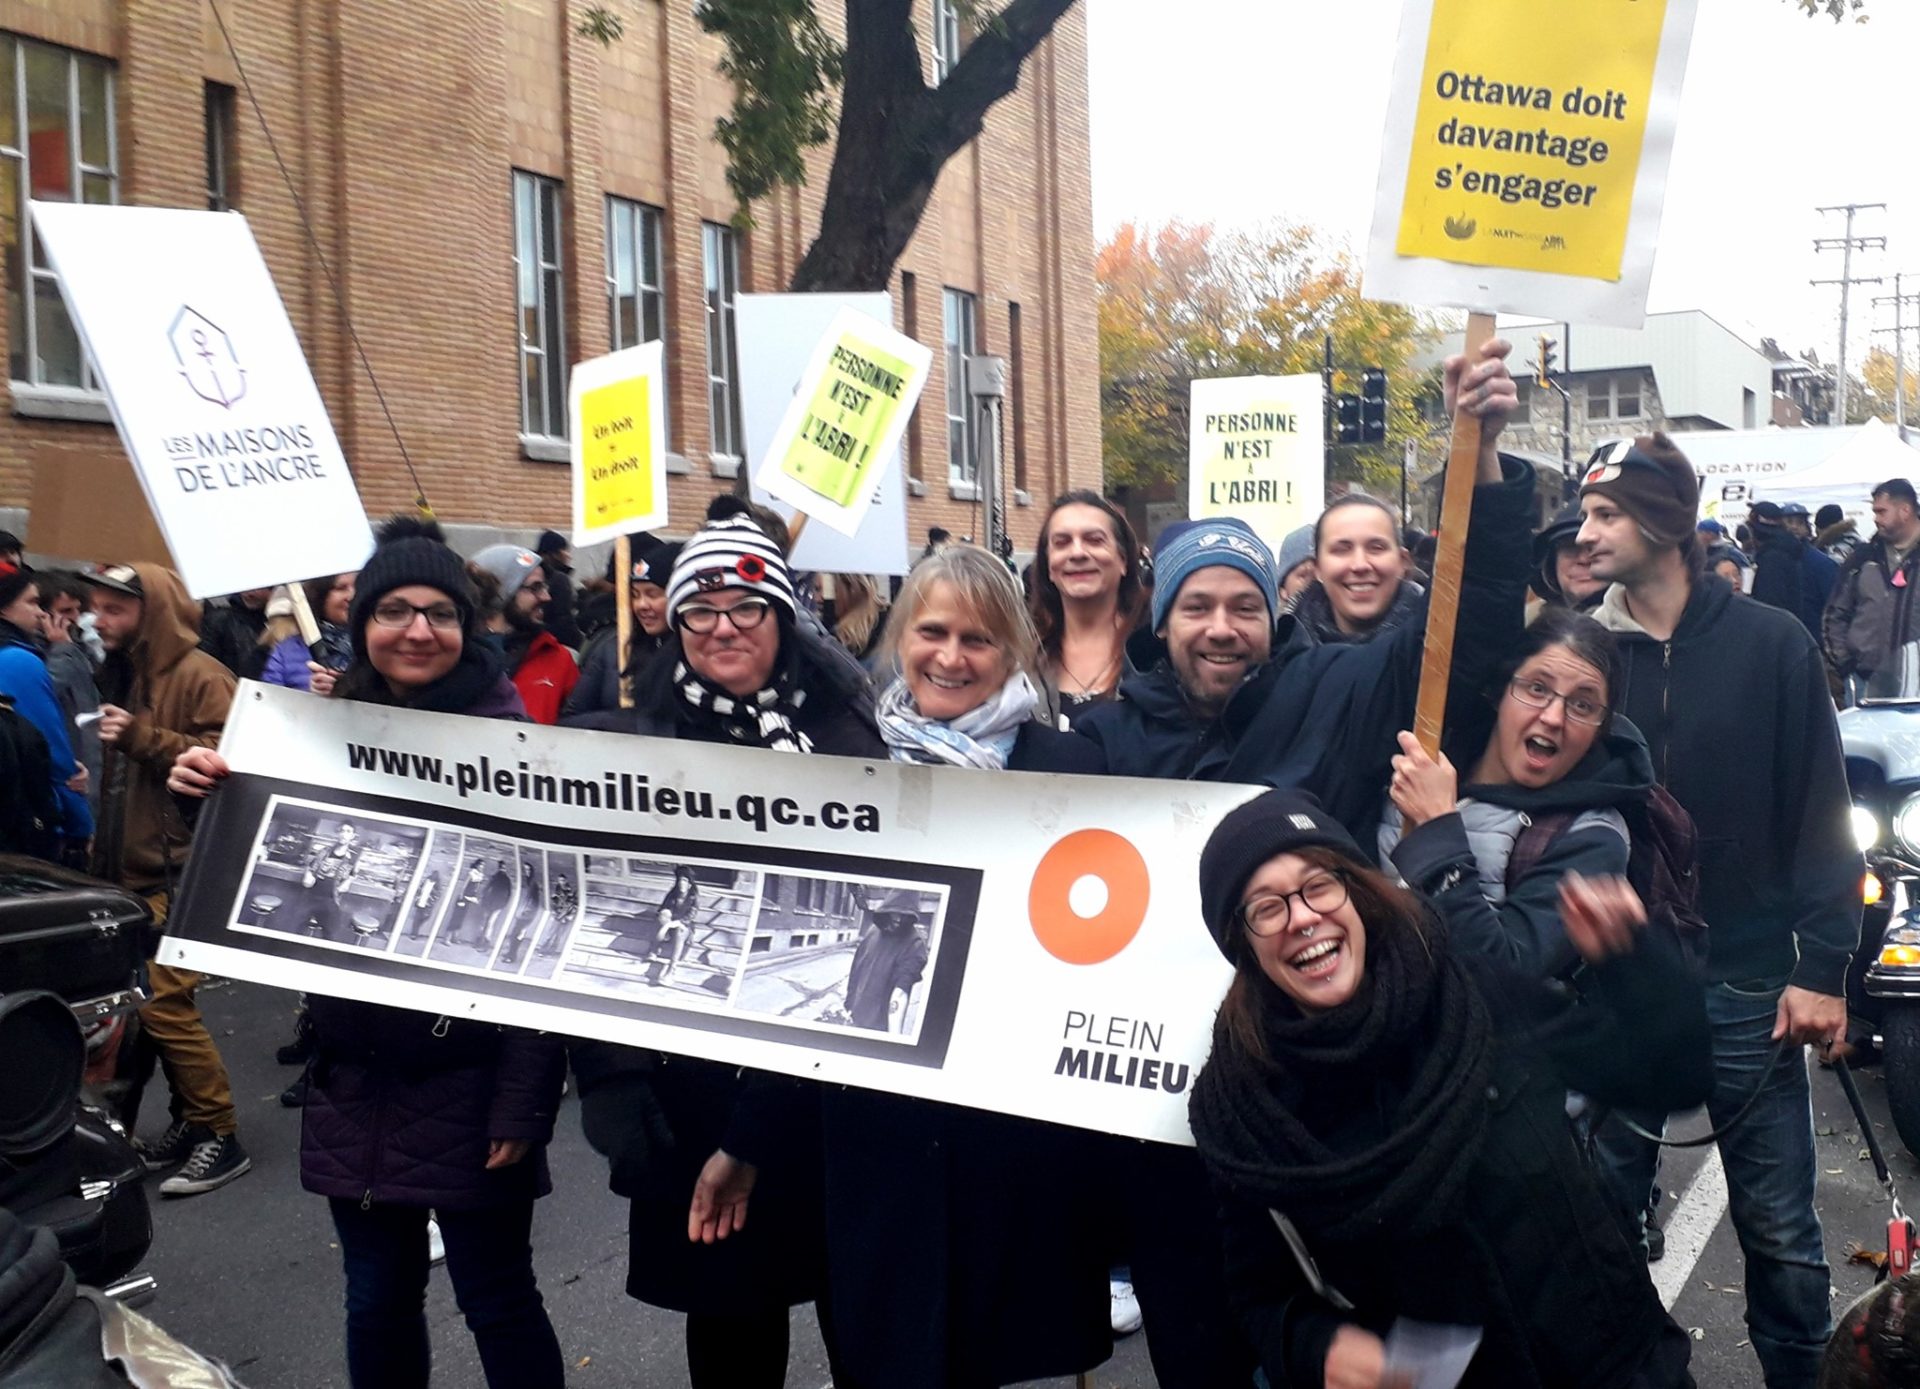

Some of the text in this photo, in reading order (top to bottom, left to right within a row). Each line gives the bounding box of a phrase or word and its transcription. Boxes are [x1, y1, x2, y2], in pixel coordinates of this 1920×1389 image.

[1436, 71, 1627, 120] Ottawa doit
[1438, 117, 1609, 167] davantage
[1435, 162, 1597, 208] s'engager
[829, 344, 906, 400] PERSONNE
[829, 378, 873, 416] N'EST
[161, 424, 314, 458] LES MAISONS
[1205, 412, 1297, 433] PERSONNE
[1224, 439, 1272, 460] N'EST
[1696, 462, 1787, 475] LOCATION
[174, 454, 327, 493] DE L'ANCRE
[1209, 480, 1277, 504] L'ABRI
[346, 742, 881, 832] www.pleinmilieu.qc.ca
[1064, 1010, 1164, 1052] PLEIN
[1054, 1046, 1190, 1094] MILIEU
